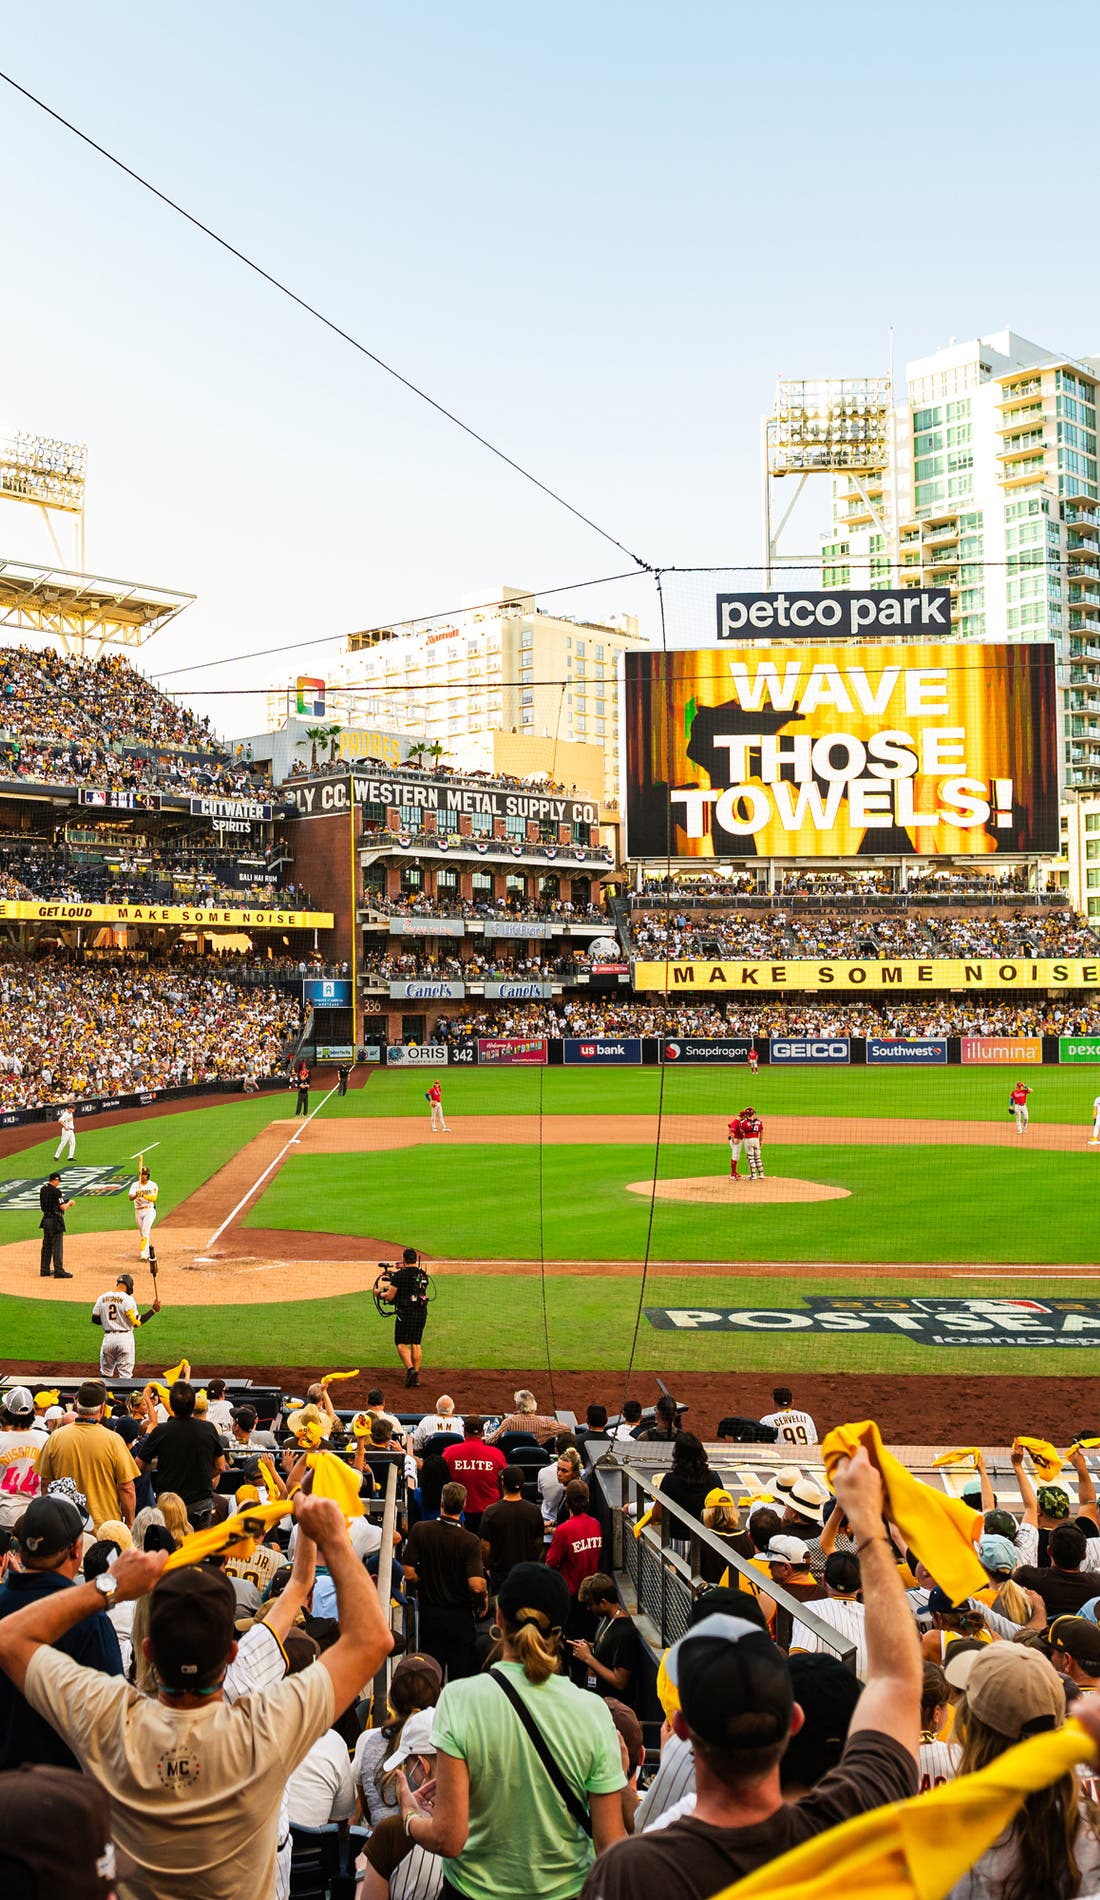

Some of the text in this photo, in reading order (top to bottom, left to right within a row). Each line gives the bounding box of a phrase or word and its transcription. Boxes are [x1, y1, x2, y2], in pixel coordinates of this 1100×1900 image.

[720, 593, 947, 637] petco park
[729, 661, 950, 716] WAVE
[339, 732, 400, 764] PADRES
[713, 727, 967, 783] THOSE
[322, 783, 350, 810] CO.
[354, 780, 598, 825] WESTERN METAL SUPPLY CO.
[201, 801, 264, 819] CUTWATER
[671, 777, 1013, 838] TOWELS!
[212, 820, 251, 833] SPIRITS
[239, 873, 253, 881] BALI
[39, 906, 93, 917] GET LOUD
[118, 908, 295, 924] MAKE SOME NOISE
[674, 964, 1098, 985] MAKE SOME NOISE
[406, 983, 452, 997] Canel's
[499, 983, 541, 997] Canel's
[364, 1000, 381, 1012] 336
[408, 1047, 445, 1059] ORIS
[453, 1049, 473, 1062] 342
[581, 1045, 624, 1055] us bank
[686, 1045, 747, 1058] Snapdragon
[773, 1043, 848, 1057] GEICO
[872, 1045, 933, 1057] Southwest
[966, 1043, 1036, 1059] illumina
[109, 1304, 117, 1320] 2
[774, 1415, 807, 1427] CERVELLI
[783, 1426, 808, 1445] 99
[454, 1459, 494, 1471] ELITE
[1, 1466, 40, 1496] 44
[254, 1553, 270, 1572] JR.
[167, 1760, 190, 1777] MC
